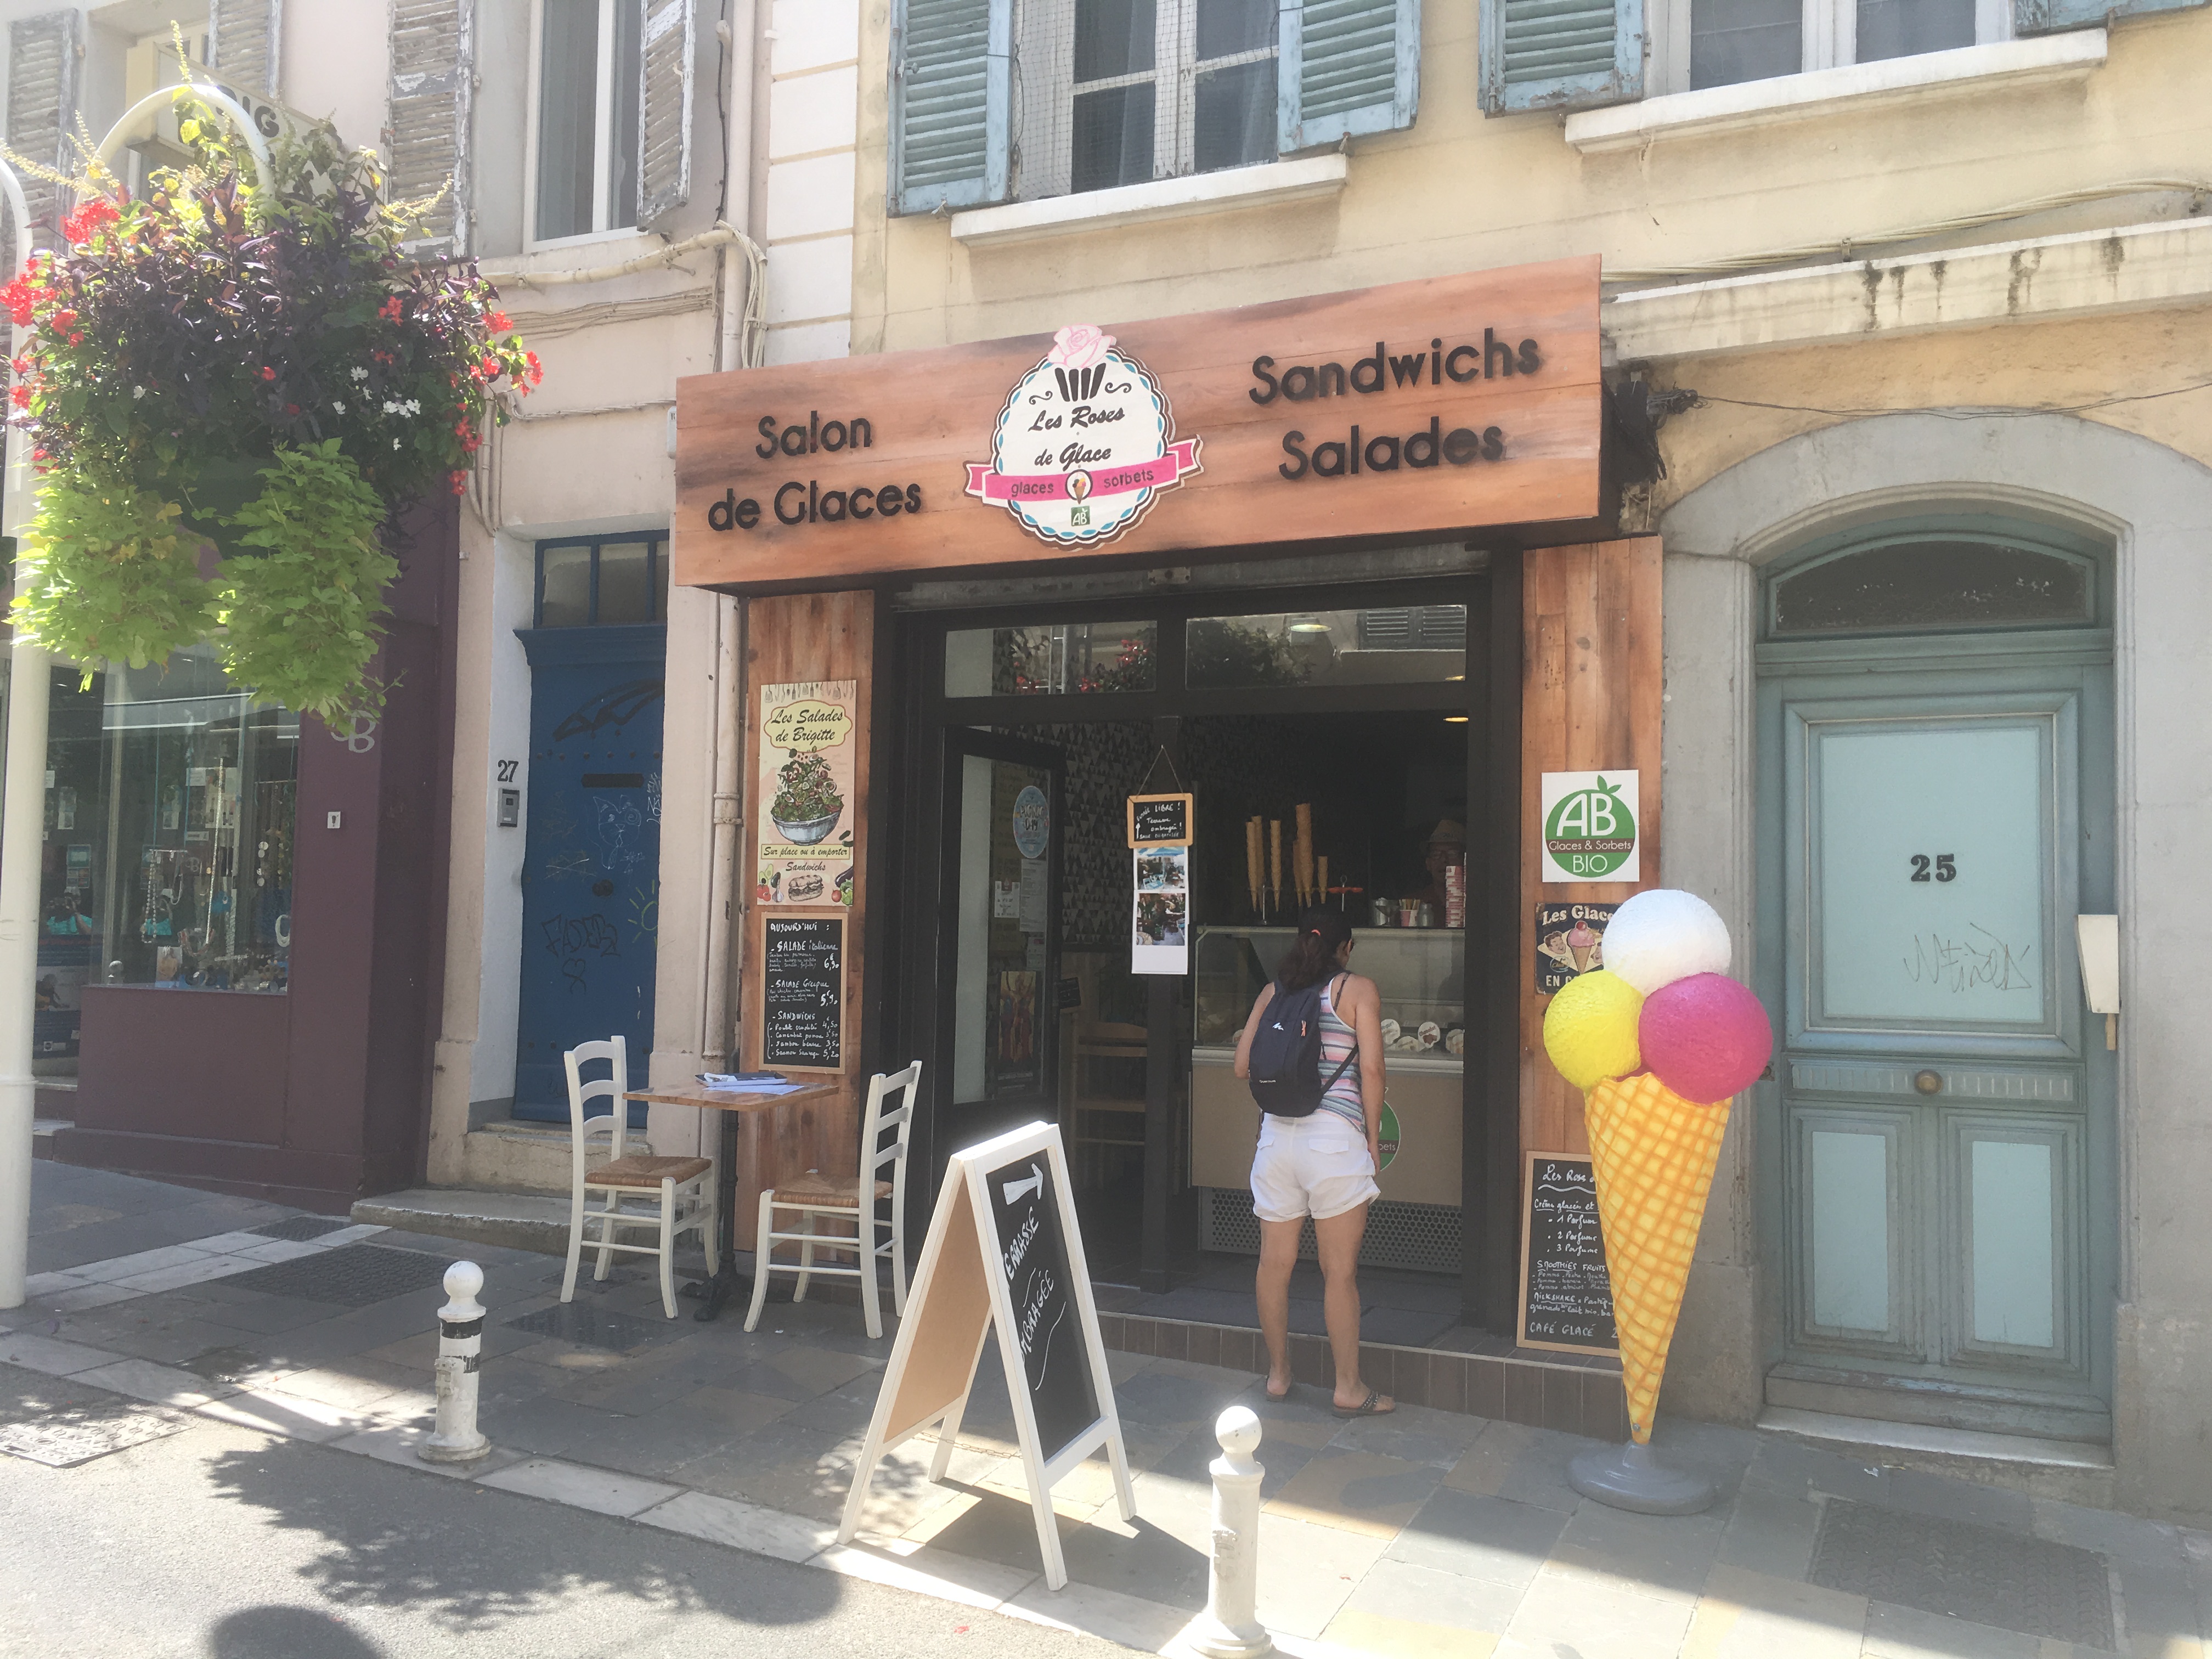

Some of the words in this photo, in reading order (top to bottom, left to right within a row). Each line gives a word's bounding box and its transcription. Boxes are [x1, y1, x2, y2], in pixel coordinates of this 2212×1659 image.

[1249, 328, 1541, 405] Sandwichs
[1028, 410, 1062, 432] Les
[1070, 406, 1125, 428] Roses
[756, 410, 871, 459] Salon
[1034, 448, 1053, 466] de
[1059, 442, 1111, 471] Glace
[1279, 416, 1504, 480] Salades
[1104, 469, 1154, 488] sorbets
[1011, 482, 1054, 496] glaces
[708, 488, 761, 531] de
[774, 481, 922, 525] Glaces
[1072, 511, 1087, 525] AB
[771, 709, 792, 724] Les
[797, 708, 843, 724] Salades
[776, 729, 789, 741] de
[793, 726, 835, 746] Brigitte
[498, 760, 518, 782] 27
[1556, 793, 1617, 837] AB
[764, 847, 778, 856] Sur
[780, 847, 798, 857] place
[810, 847, 816, 855] à
[817, 848, 848, 857] emporter
[1549, 840, 1582, 851] Glaces
[1584, 840, 1593, 850] &
[1595, 839, 1632, 851] Sorbets
[786, 861, 826, 871] Sandwichs
[1572, 855, 1608, 873] BIO
[1910, 853, 1957, 882] 25
[1542, 909, 1567, 926] Les
[1571, 905, 1614, 922] Glace
[777, 940, 806, 952] SALADE
[775, 979, 800, 988] SALADE
[1545, 975, 1560, 986] EN
[1542, 1163, 1562, 1181] Les
[1585, 1201, 1595, 1210] et
[1556, 1214, 1564, 1223] 1
[1003, 1206, 1039, 1282] ERRASSE
[1557, 1231, 1564, 1239] 2
[1556, 1243, 1562, 1251] 3
[1530, 1321, 1558, 1334] CAFÉ
[1561, 1323, 1596, 1337] GLACÉ
